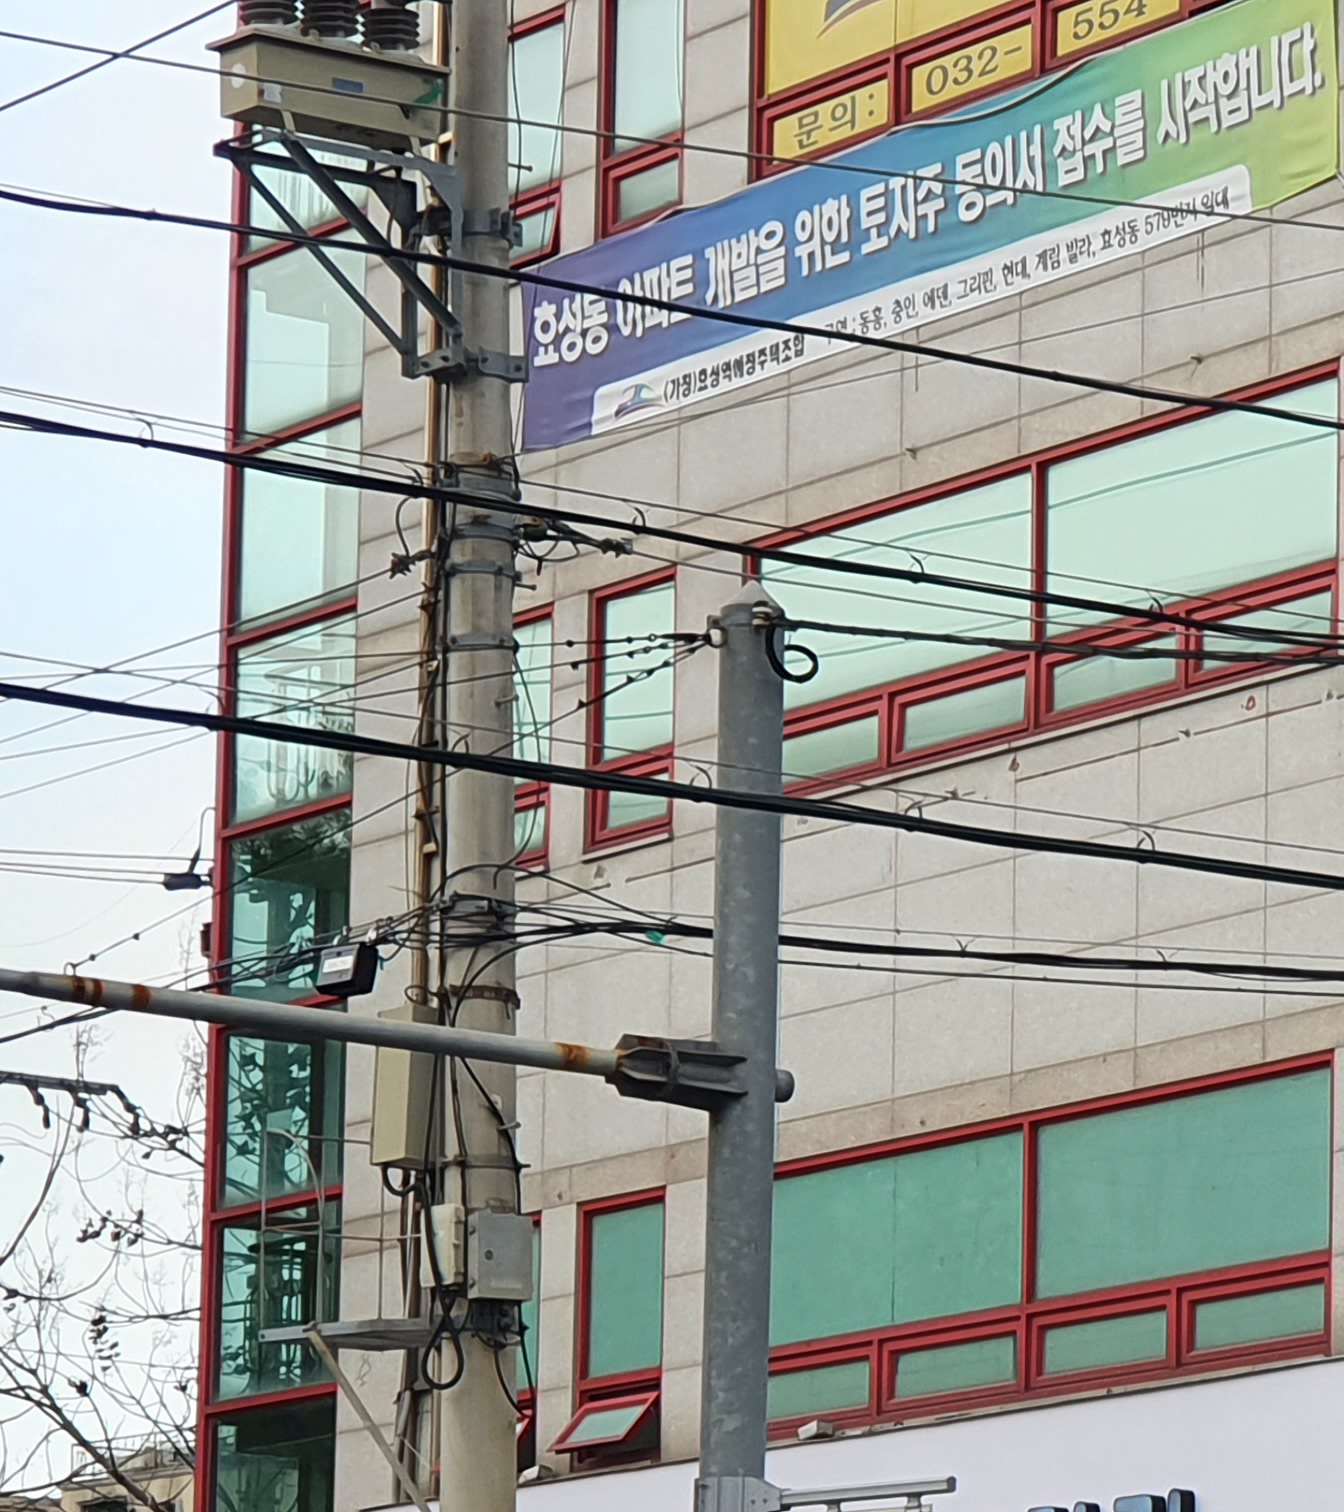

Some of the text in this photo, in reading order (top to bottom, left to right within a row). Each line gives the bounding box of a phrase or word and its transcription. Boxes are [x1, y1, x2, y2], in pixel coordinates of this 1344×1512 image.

[533, 22, 1325, 367] 효성동 아파트 개발을 위한 토지주 동의서 접수를 시작합니다.
[793, 92, 876, 150] 문의:
[925, 45, 1022, 96] 032-
